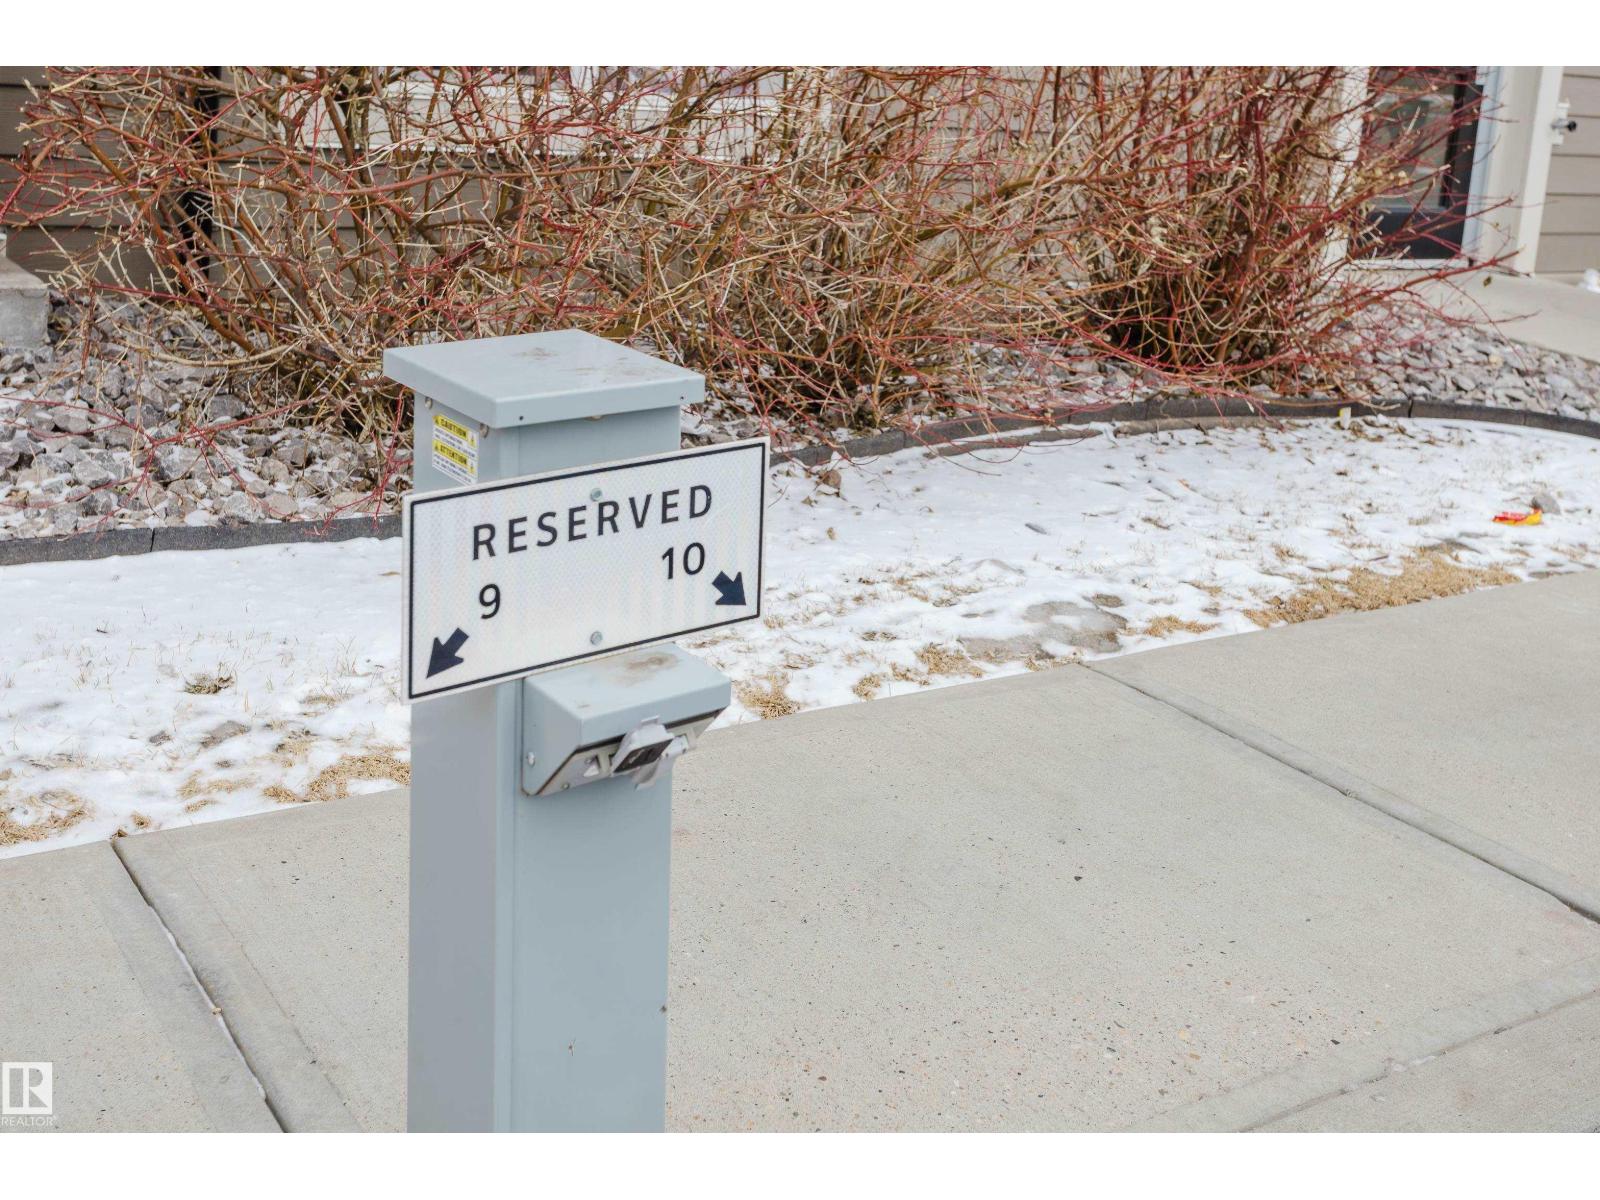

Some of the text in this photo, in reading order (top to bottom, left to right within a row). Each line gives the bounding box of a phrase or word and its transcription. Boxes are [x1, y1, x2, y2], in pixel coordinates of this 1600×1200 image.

[473, 484, 712, 561] RESERVED
[661, 542, 706, 580] 10
[478, 583, 501, 620] 9
